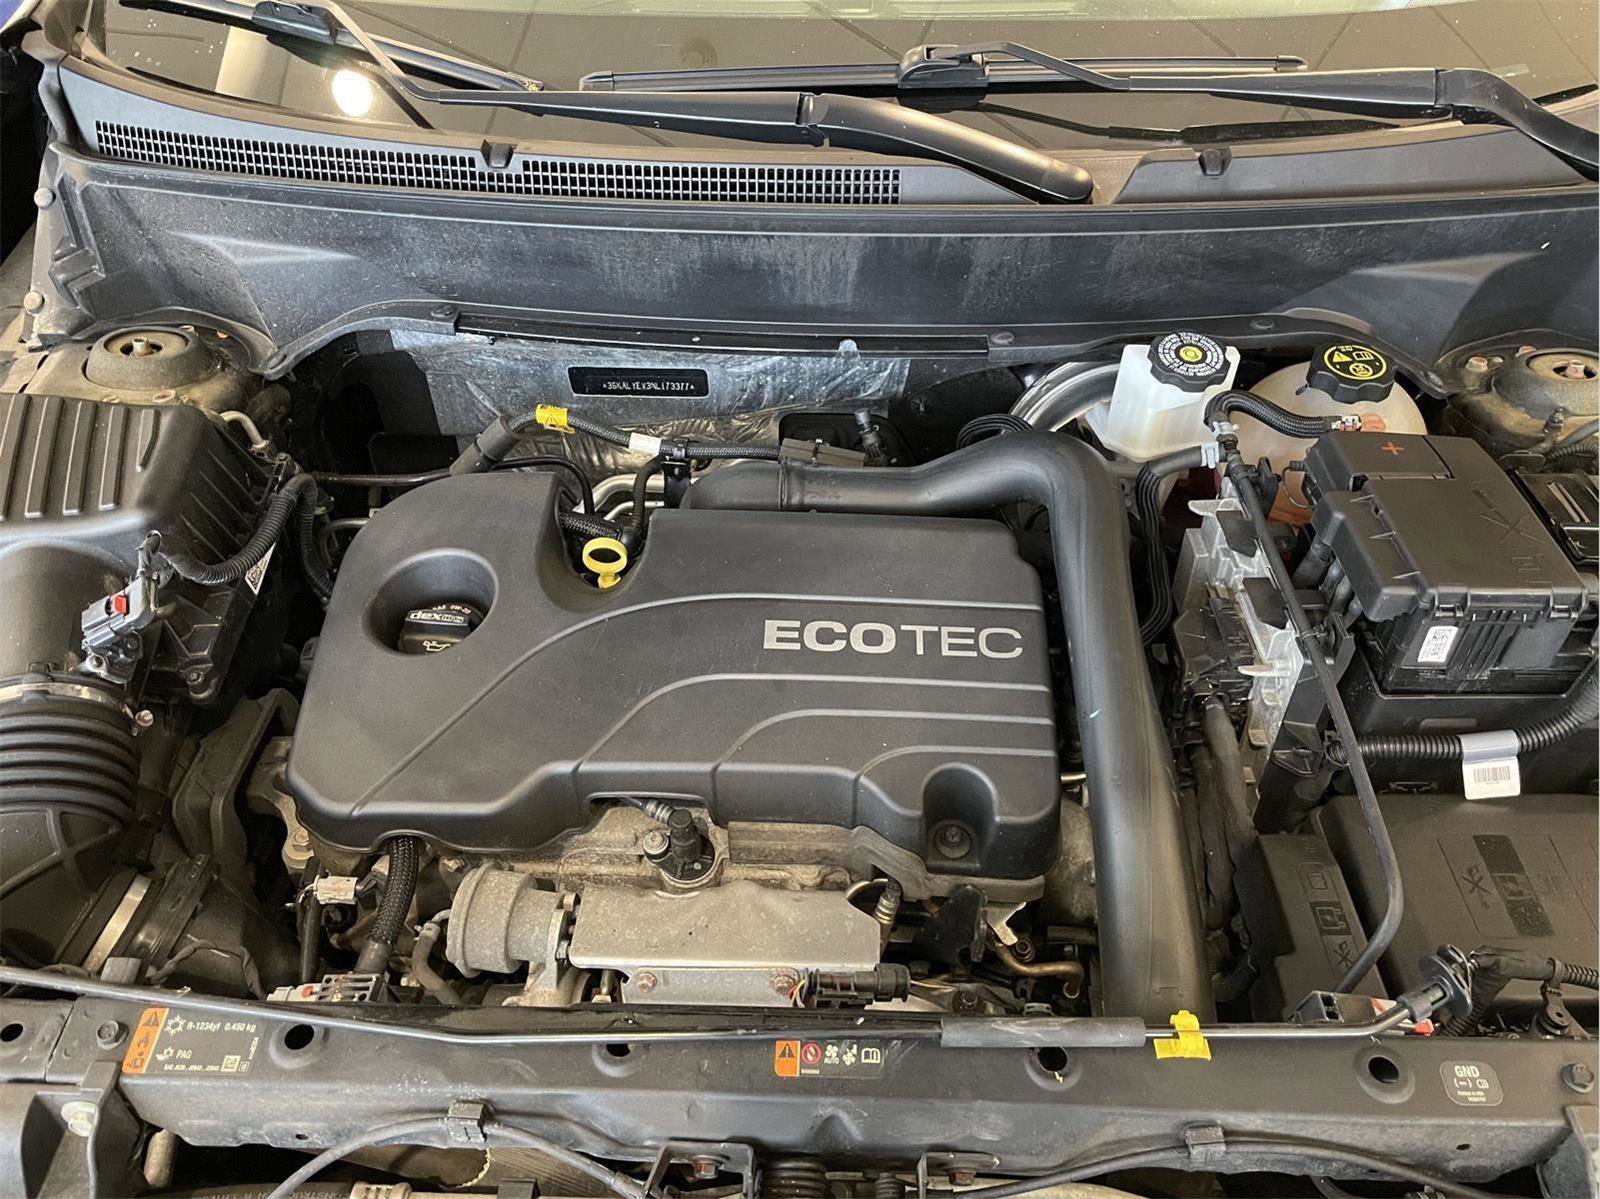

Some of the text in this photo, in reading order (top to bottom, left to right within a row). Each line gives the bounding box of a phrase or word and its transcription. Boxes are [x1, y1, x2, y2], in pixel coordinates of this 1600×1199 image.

[409, 610, 465, 624] dexos
[763, 620, 1024, 659] ECOTEC
[186, 1021, 257, 1033] R-1234yf 0.450 kg
[175, 1049, 193, 1060] PAG
[824, 1057, 840, 1065] AUTO
[1454, 1065, 1480, 1078] GND
